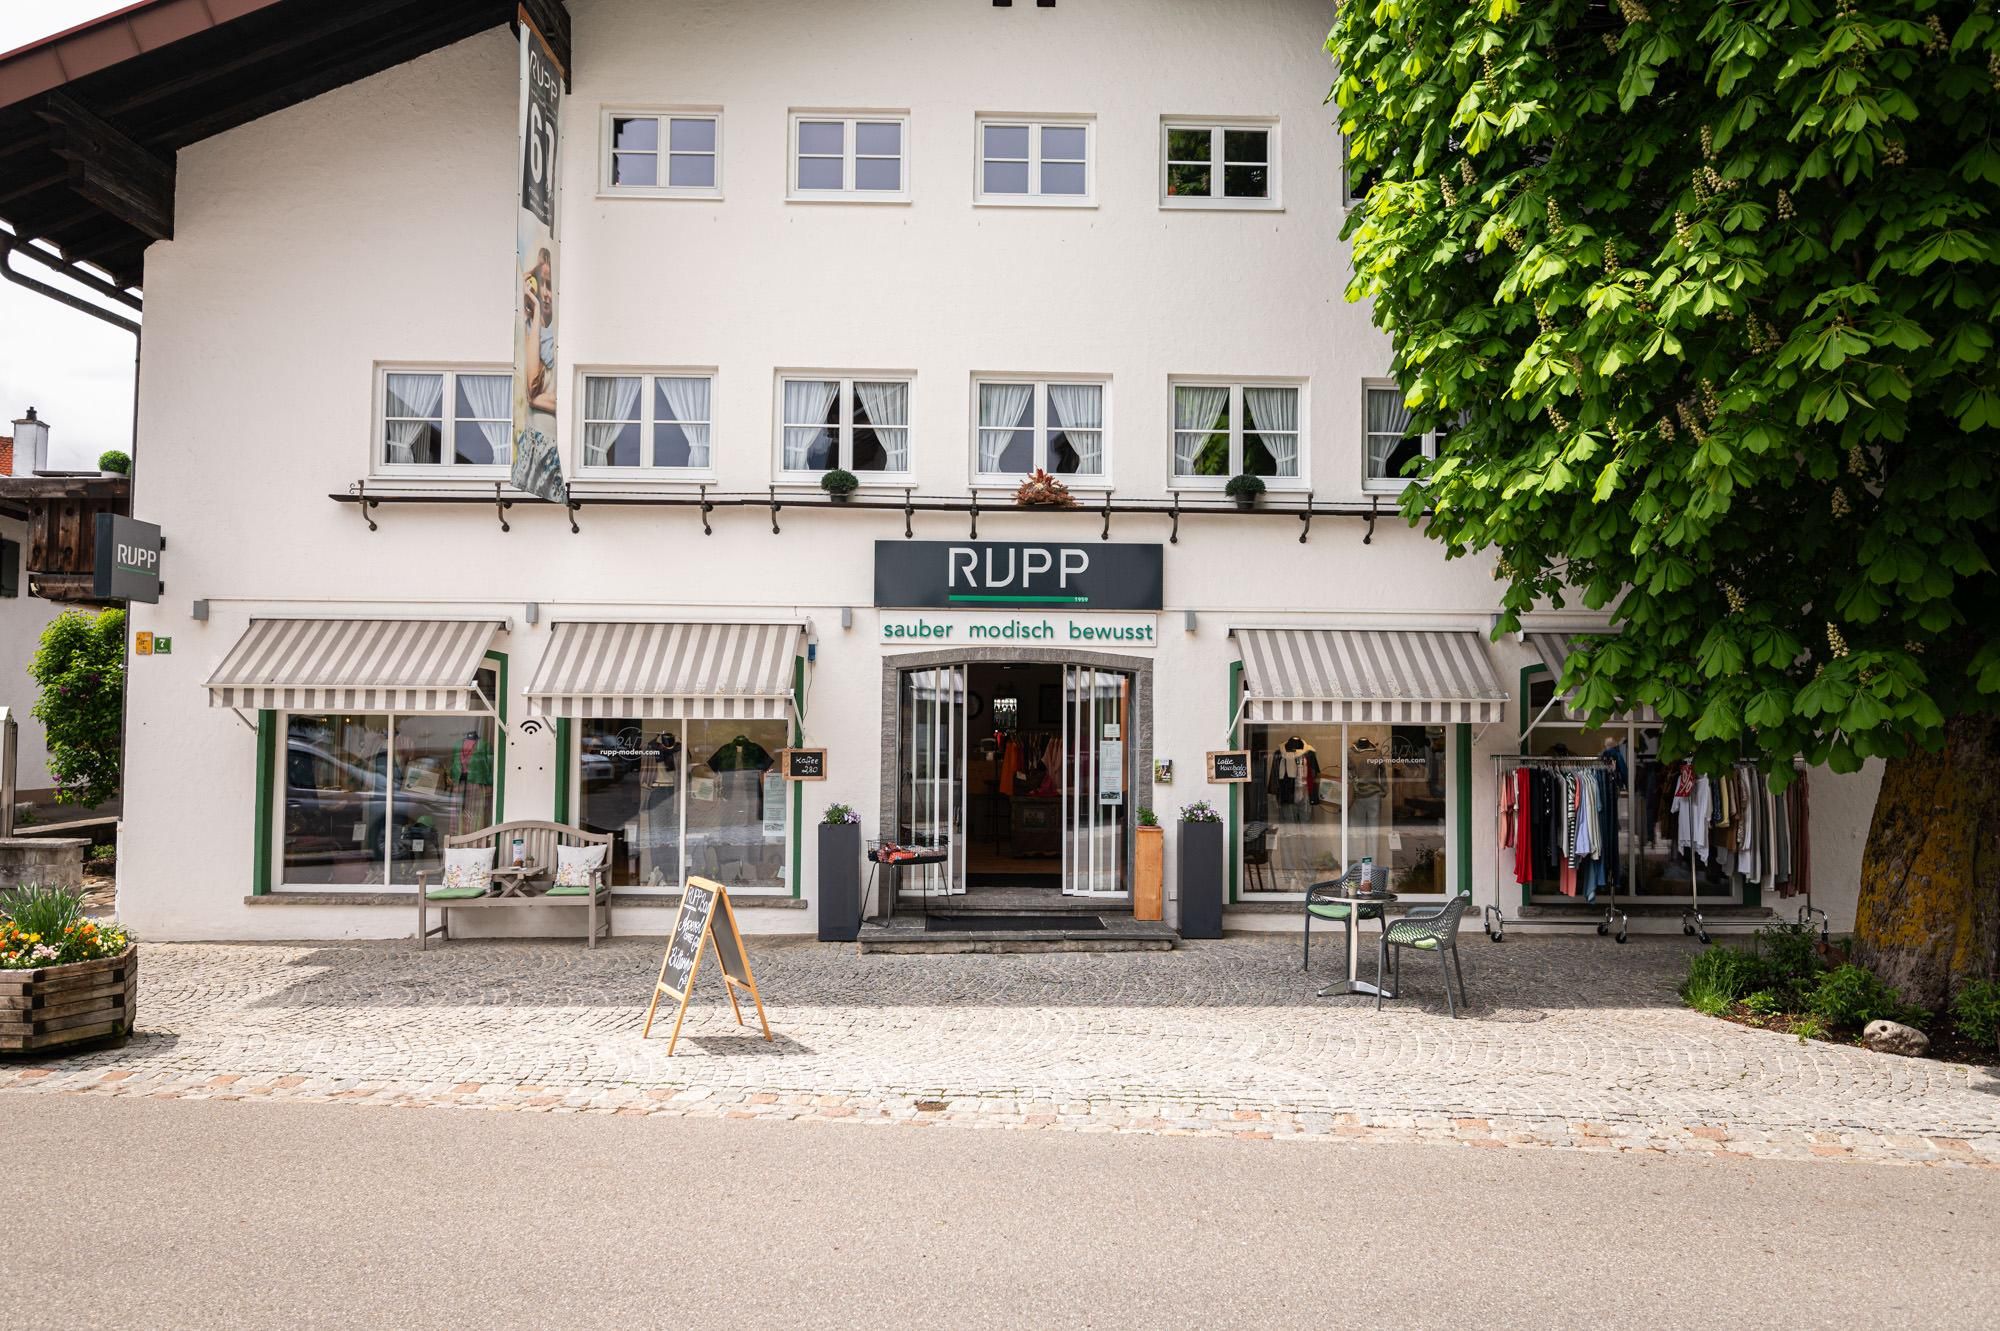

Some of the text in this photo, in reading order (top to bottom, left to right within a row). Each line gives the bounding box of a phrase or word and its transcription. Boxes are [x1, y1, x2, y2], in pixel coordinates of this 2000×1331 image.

[117, 543, 157, 569] RUPP
[948, 547, 1090, 589] RUPP
[883, 618, 1153, 640] sauber modisch bewusst
[159, 639, 165, 648] 7
[600, 748, 660, 757] rupp-moden.com
[795, 755, 819, 765] Kaffee
[1366, 757, 1426, 765] rupp-moden.com
